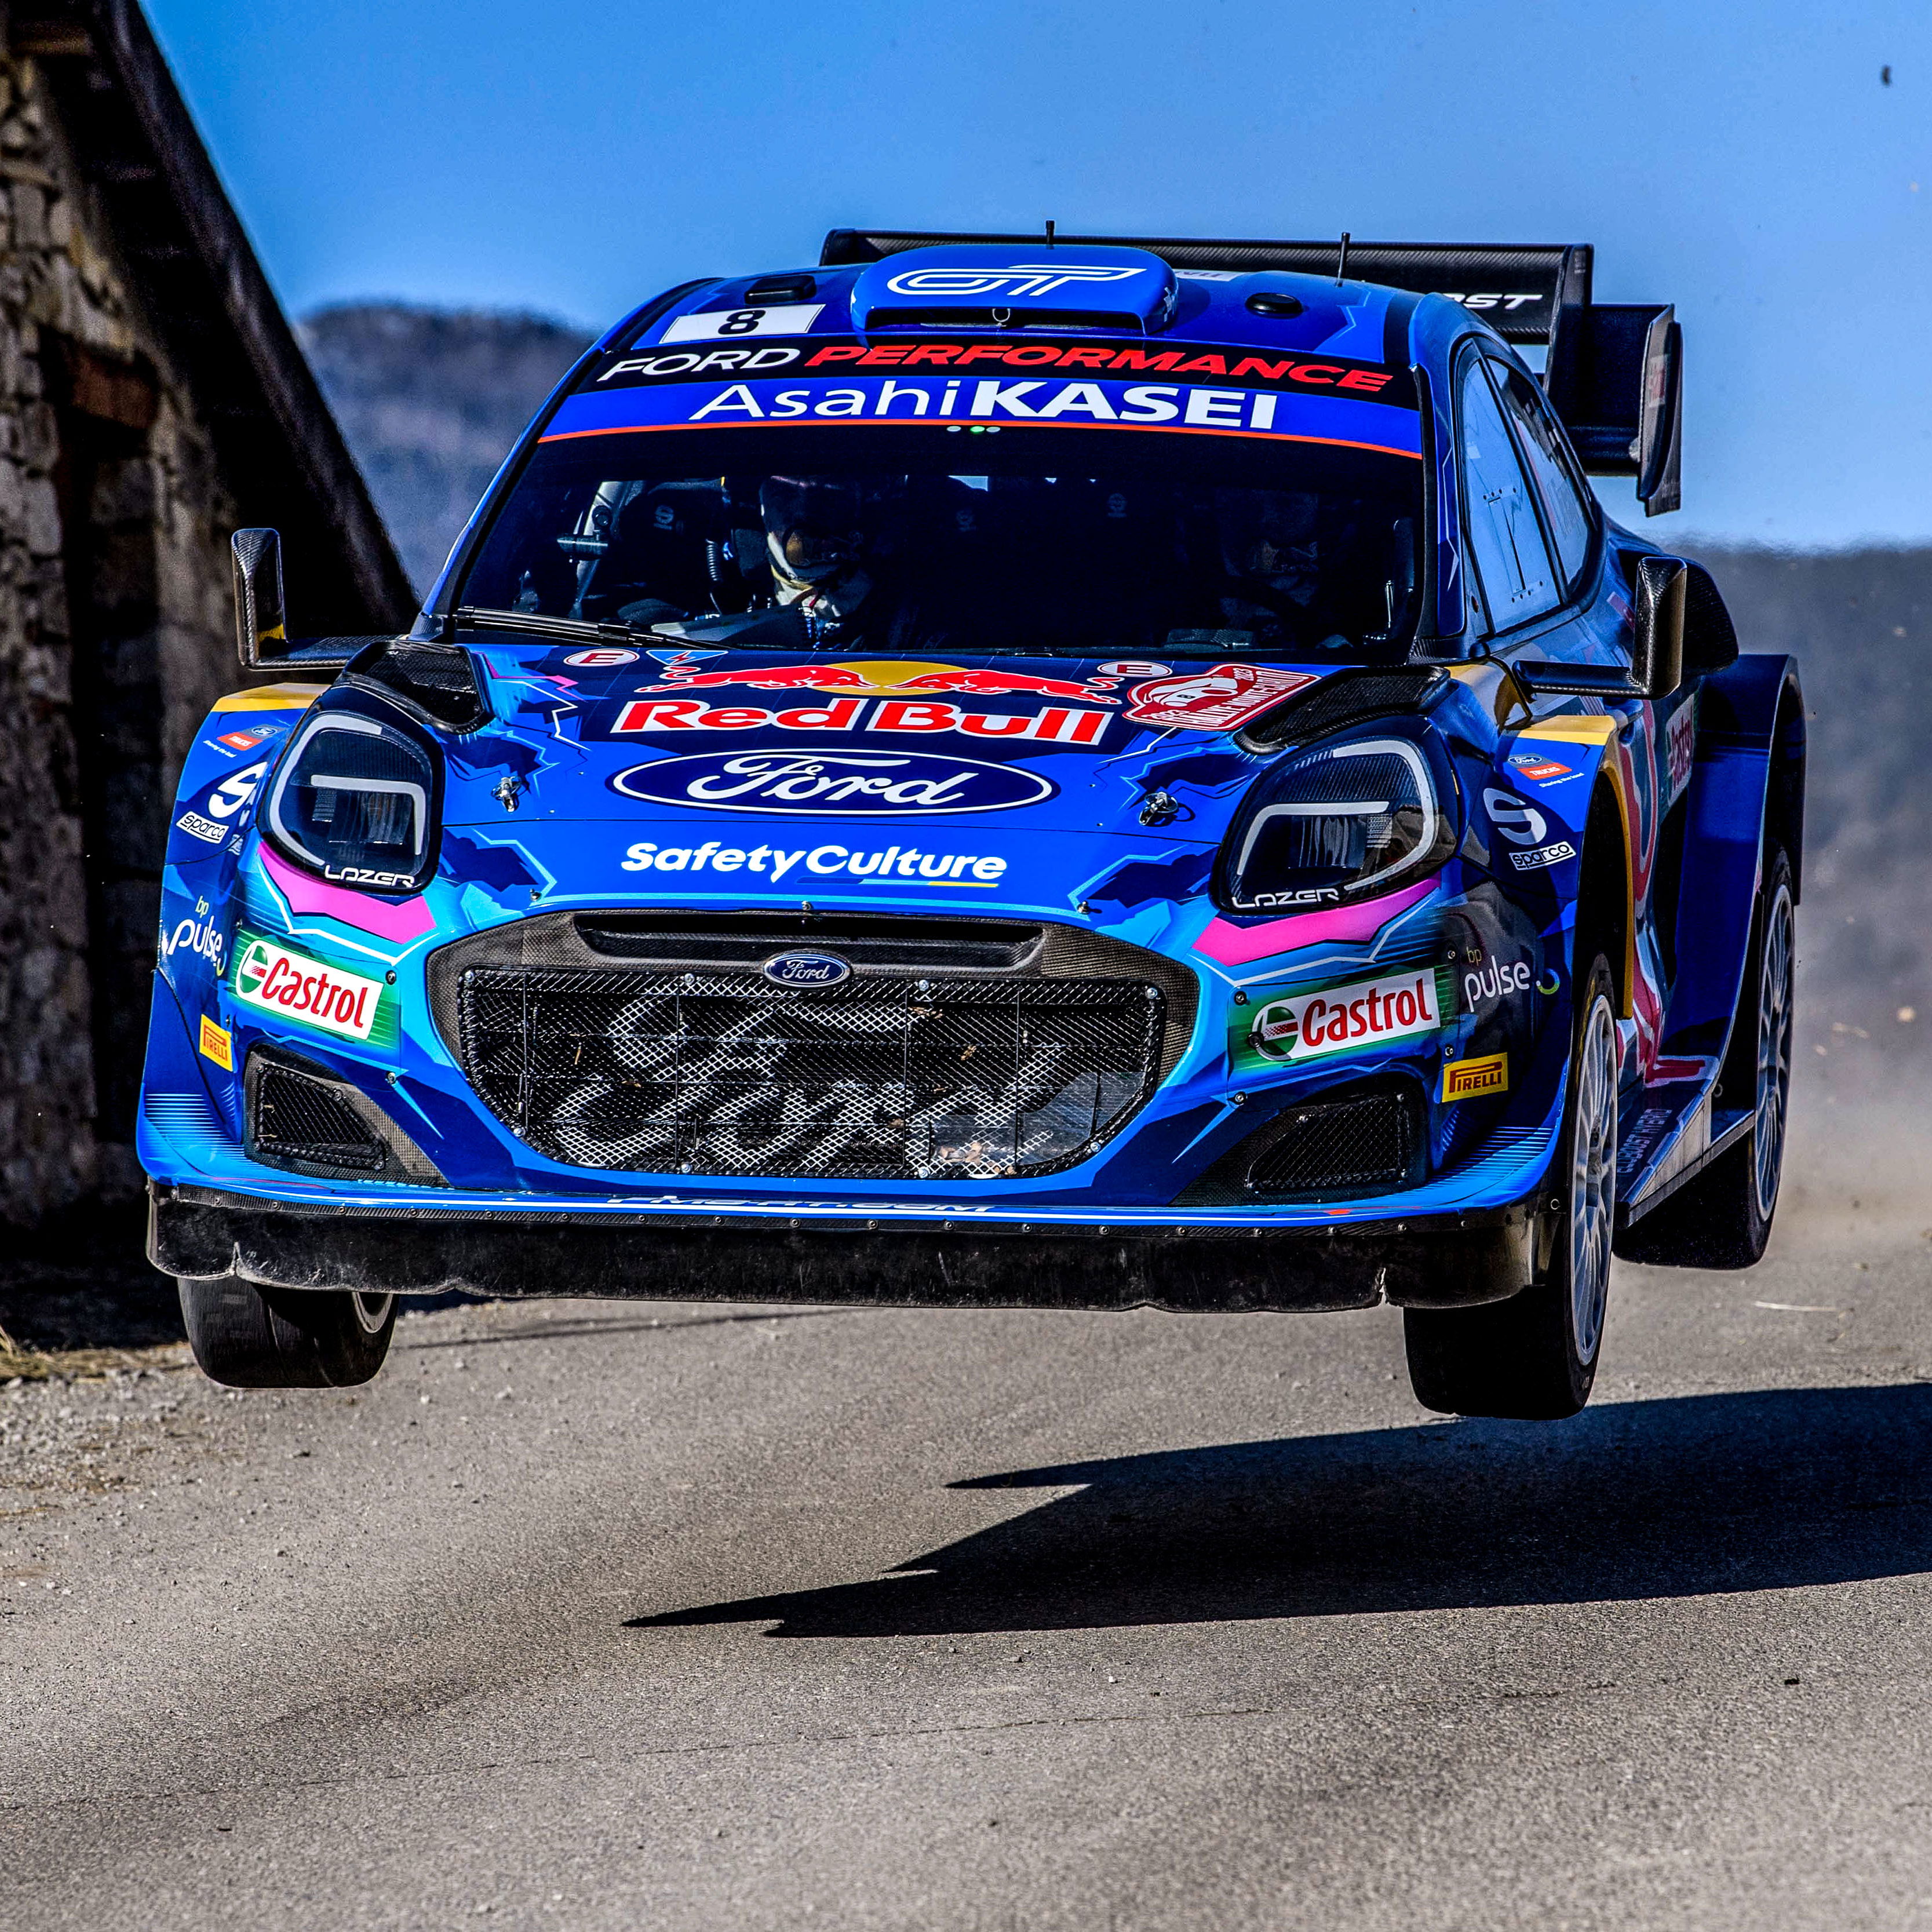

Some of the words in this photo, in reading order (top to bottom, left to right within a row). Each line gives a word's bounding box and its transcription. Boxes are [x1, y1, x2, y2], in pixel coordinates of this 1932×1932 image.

[717, 310, 766, 335] 8
[597, 348, 800, 382] FORD
[804, 345, 1392, 392] PERFORMANCE
[610, 698, 869, 734] Red
[864, 699, 1114, 746] Bull
[686, 754, 979, 805] Ford
[1529, 767, 1561, 776] TRUCKS
[184, 815, 225, 838] sparco
[1512, 842, 1570, 869] sparco
[195, 895, 209, 918] bp
[167, 915, 223, 962] pulse
[1467, 947, 1482, 964] bp
[781, 960, 830, 980] Ford
[1464, 960, 1530, 1012] pulse
[261, 957, 369, 1028] Castrol
[1302, 978, 1432, 1047] Castrol
[203, 1024, 228, 1062] PIRELLI
[1449, 1061, 1502, 1093] PIRELLI
